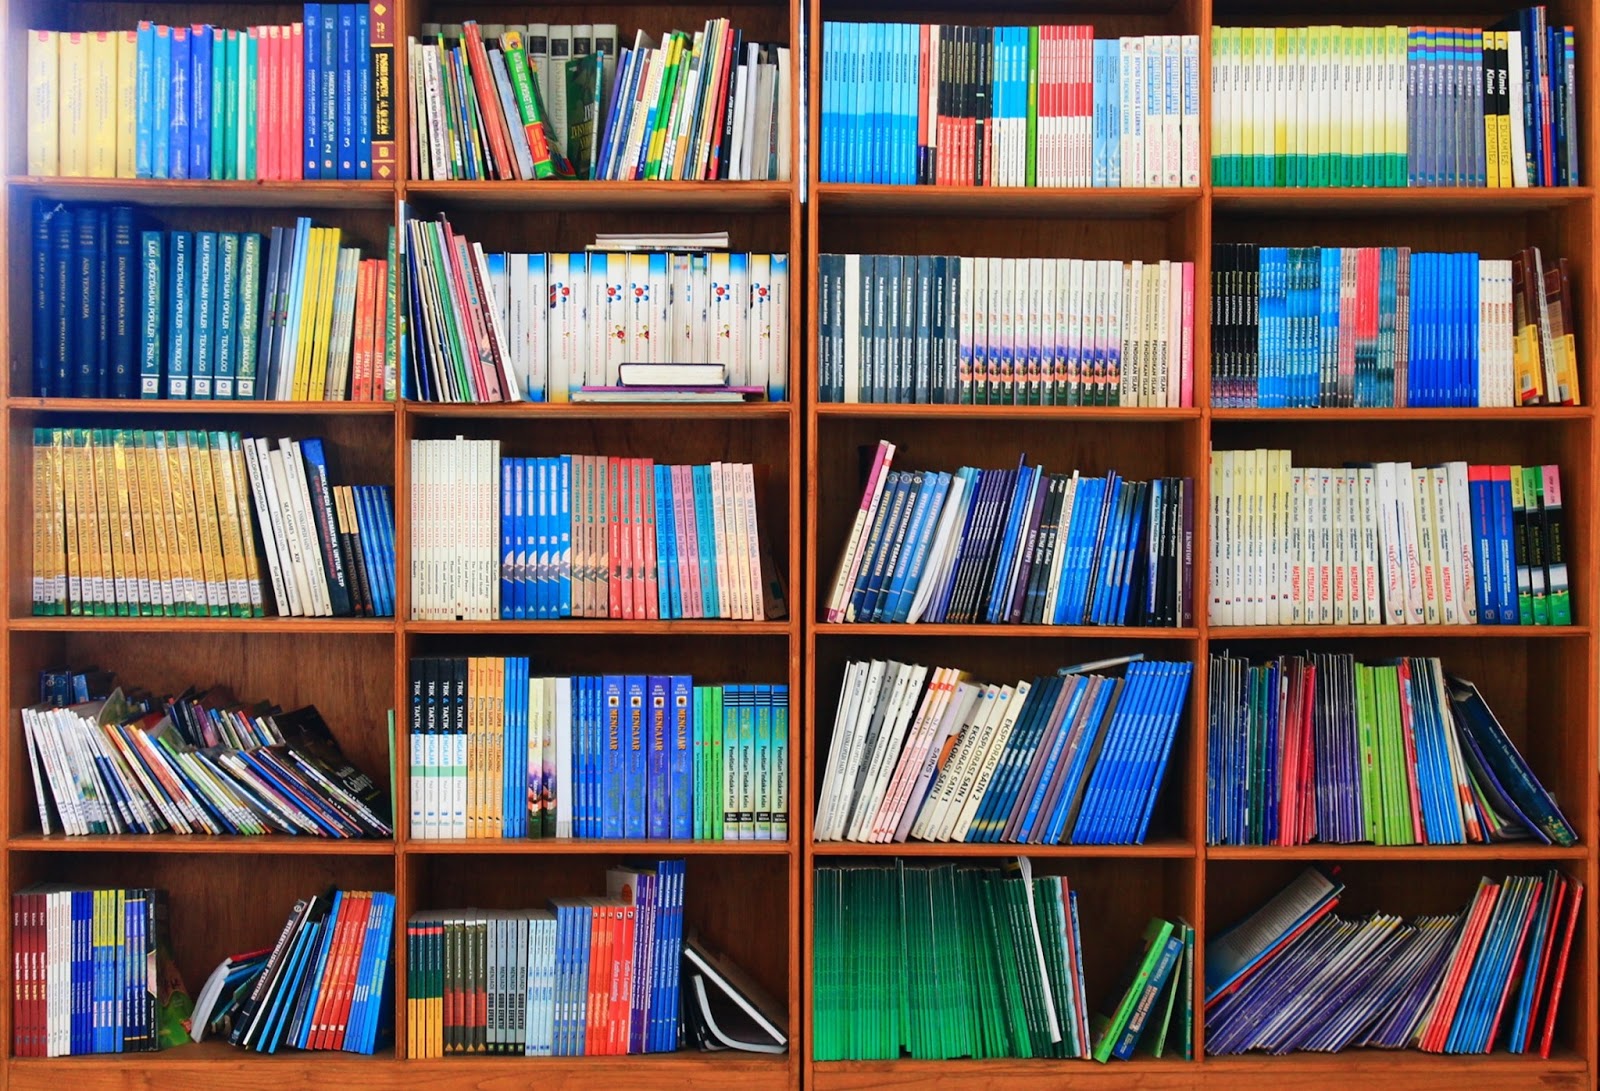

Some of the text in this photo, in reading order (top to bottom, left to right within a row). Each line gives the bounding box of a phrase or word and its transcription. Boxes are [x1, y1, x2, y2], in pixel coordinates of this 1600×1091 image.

[1486, 69, 1495, 94] Kimia
[1498, 69, 1507, 95] Kimia
[309, 138, 314, 148] 1
[325, 144, 331, 153] 2
[344, 137, 350, 148] 3
[1488, 124, 1497, 165] DUMMIES
[1500, 125, 1509, 165] DUMMIES
[471, 297, 478, 305] 3
[147, 308, 155, 337] POPULER
[82, 365, 89, 374] 5
[117, 365, 124, 374] 6
[375, 352, 383, 378] JENSEN
[247, 445, 266, 512] ENSIKLOPEDI OLAHRAGA
[286, 514, 295, 535] GAMES
[326, 507, 338, 548] MATEMATIKA
[871, 490, 892, 542] INTELEKTUALISME
[897, 492, 916, 543] INTELEKTUALISME
[333, 549, 342, 571] UNTUK
[1025, 530, 1036, 563] EKSOTOPI
[336, 572, 344, 587] SLTP
[1321, 566, 1329, 601] MATEMATIKA
[1350, 566, 1359, 601] MATEMATIKA
[1442, 566, 1451, 602] MATEMATIKA
[610, 708, 619, 750] MENGAJAR
[632, 710, 640, 750] MENGAJAR
[677, 708, 687, 750] MENGAJAR
[986, 718, 1014, 770] EKSPLORASI
[927, 747, 940, 773] SAINS
[954, 725, 980, 775] EKSPLORASI
[967, 725, 993, 776] EKSPLORASI
[944, 776, 958, 796] SAIN
[957, 777, 972, 797] SAIN
[976, 772, 990, 793] SAIN
[266, 920, 293, 968] INTELEKTUALISME
